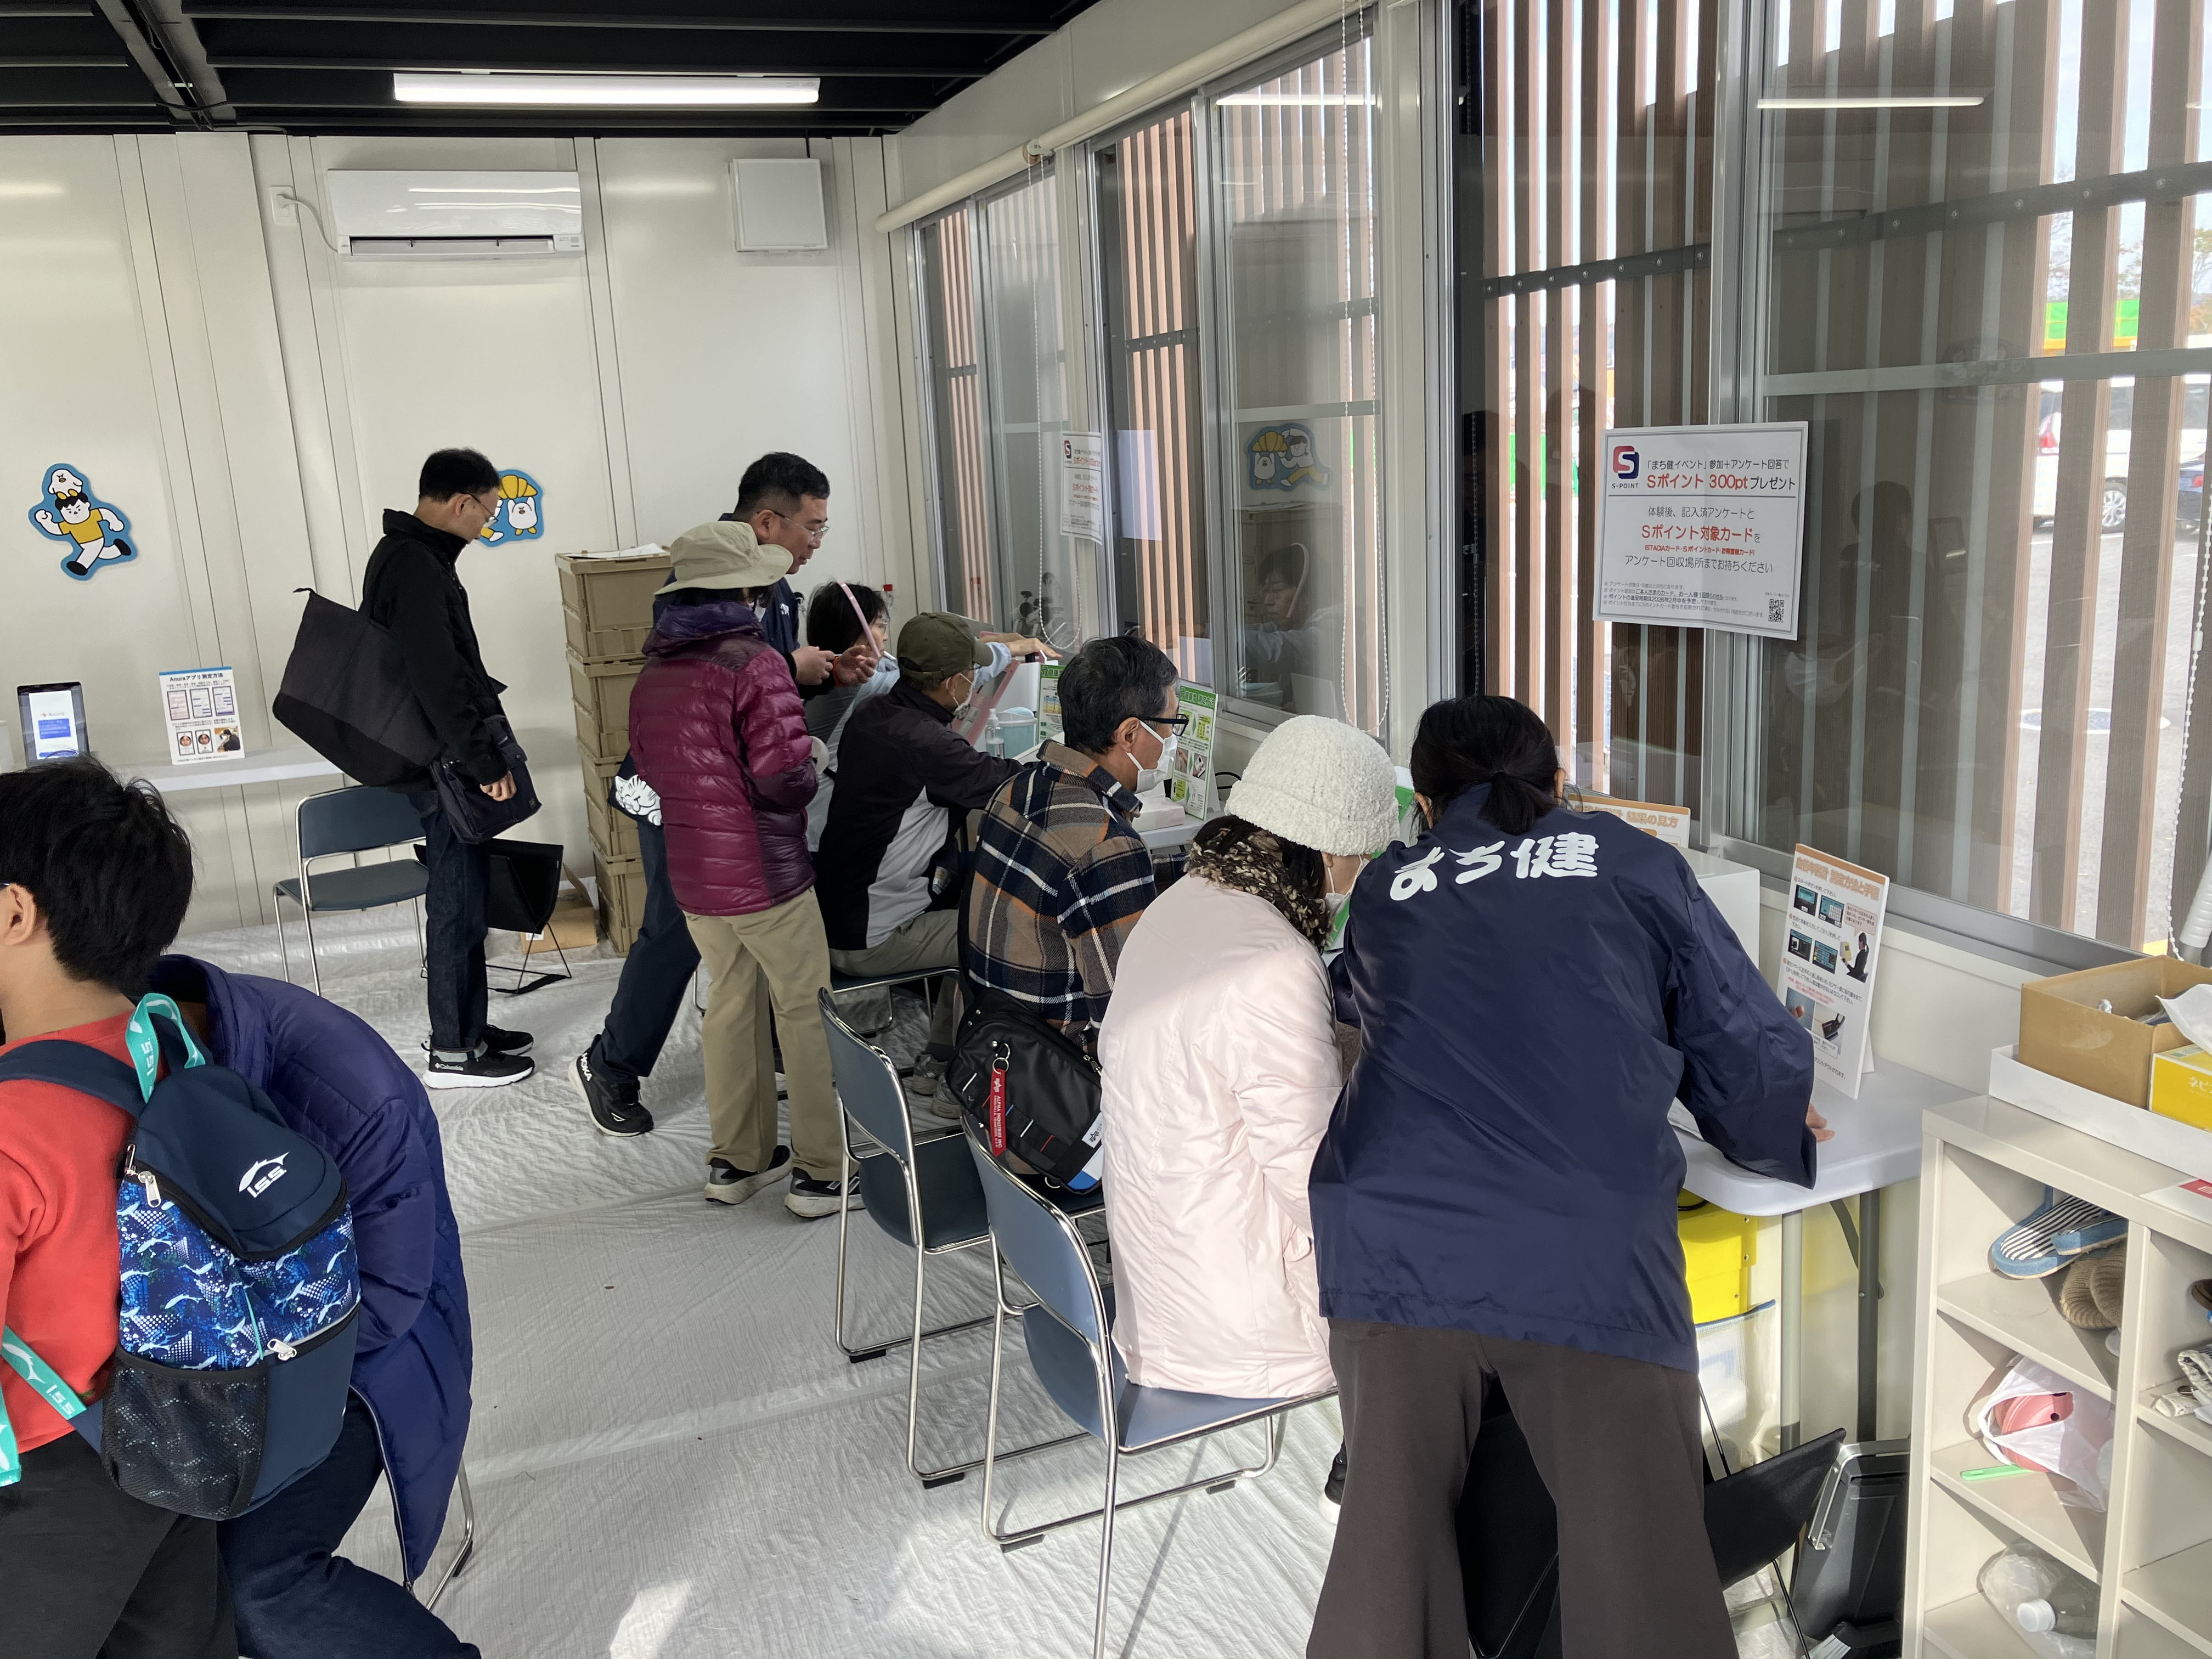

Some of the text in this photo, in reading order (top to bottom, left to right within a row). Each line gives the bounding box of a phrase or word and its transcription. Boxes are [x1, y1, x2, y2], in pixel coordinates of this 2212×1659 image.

[1646, 473, 1704, 489] Sポイント
[1625, 555, 1774, 573] アンケート回収場所までお持ちください
[1626, 810, 1679, 828] 結果の見方
[580, 1052, 592, 1081] HOKA
[247, 1165, 287, 1198] I.S.S.
[46, 1384, 75, 1418] I.S.S.
